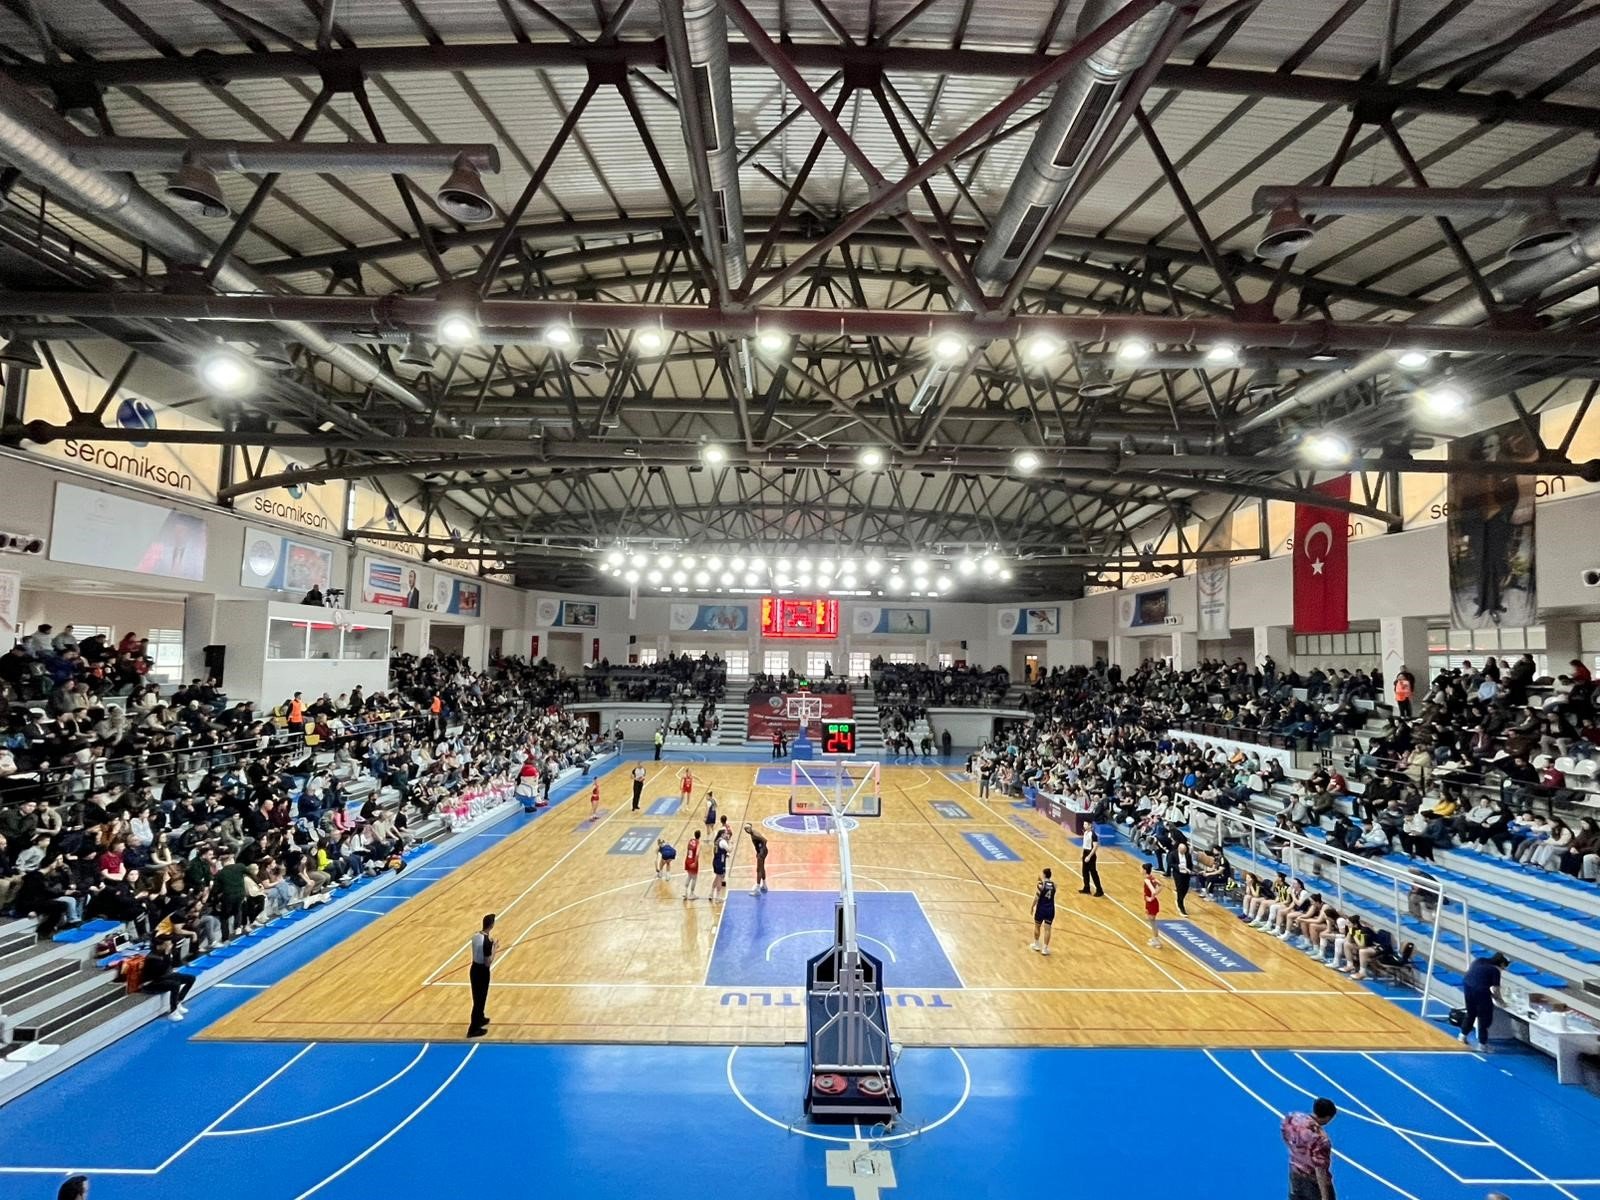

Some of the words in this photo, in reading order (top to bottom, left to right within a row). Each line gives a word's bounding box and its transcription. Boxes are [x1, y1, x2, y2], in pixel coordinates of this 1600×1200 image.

[64, 438, 191, 491] seramiksan
[254, 496, 328, 530] seramiksan
[828, 731, 851, 752] 24
[1177, 929, 1241, 968] HALKBANK
